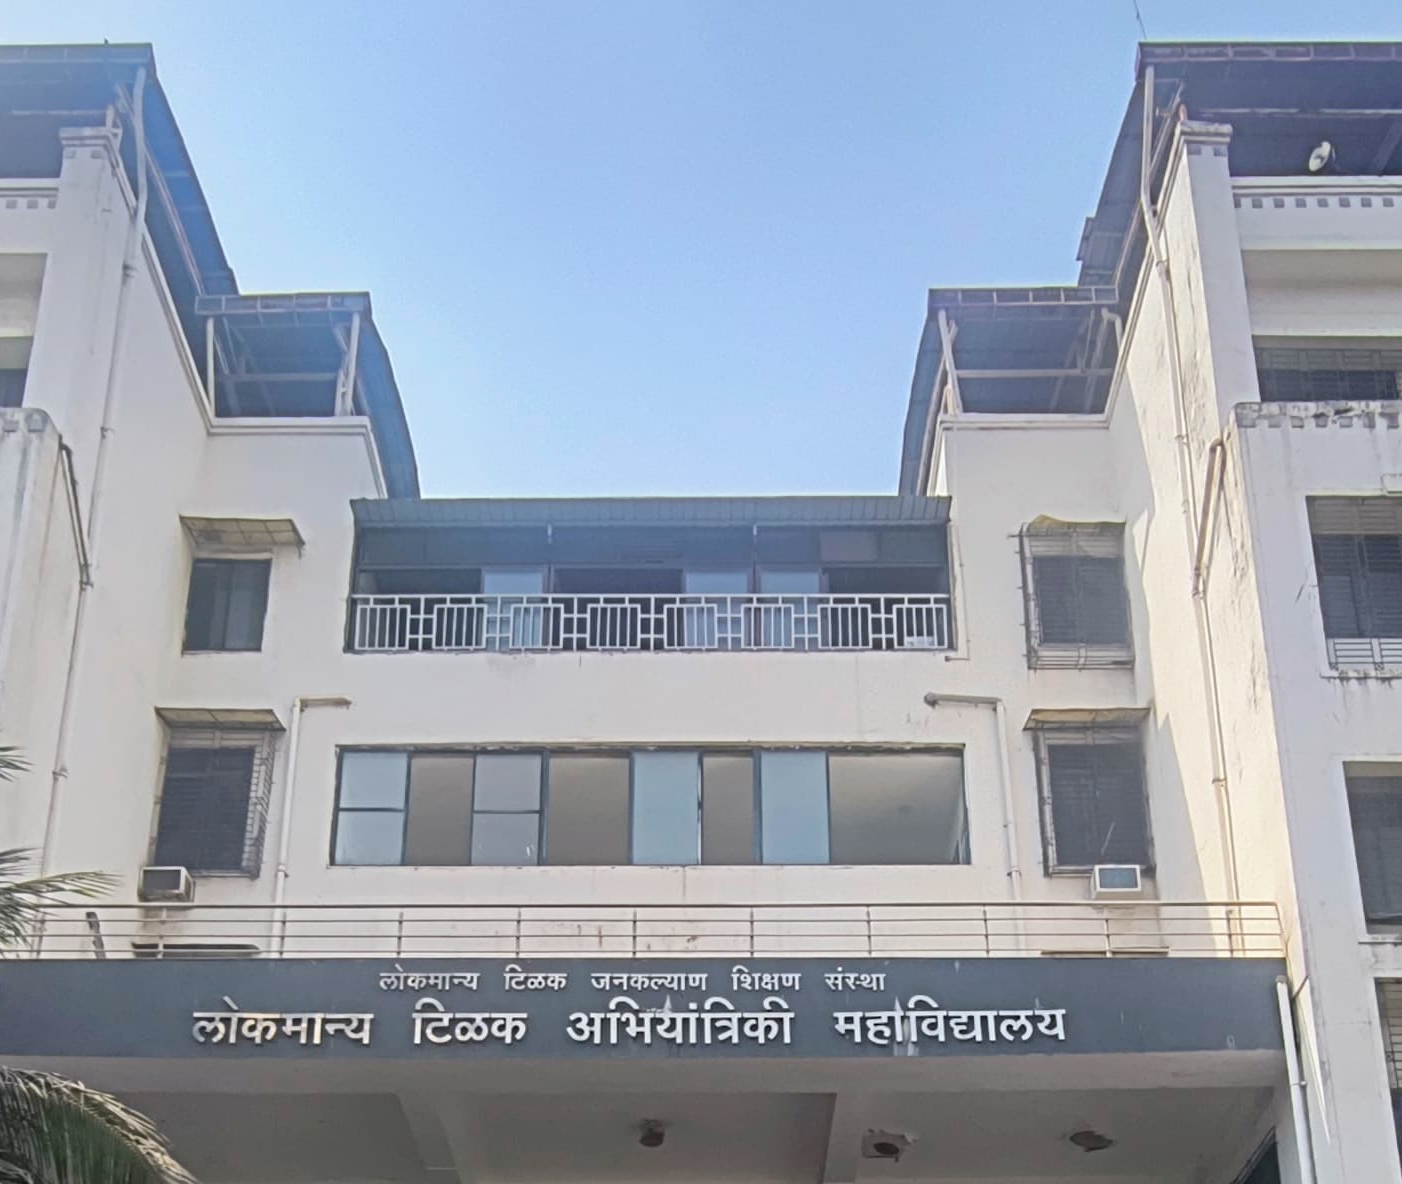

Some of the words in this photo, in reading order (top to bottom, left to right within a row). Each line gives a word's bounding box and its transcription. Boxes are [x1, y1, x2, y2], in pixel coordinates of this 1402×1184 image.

[379, 963, 480, 990] लोकमान्य
[503, 963, 568, 990] टिळक
[590, 972, 708, 991] जनकल्याण
[731, 964, 802, 991] शिक्षण
[824, 966, 886, 991] संस्था
[192, 995, 375, 1045] लोकमान्य
[412, 997, 528, 1044] टिळक
[566, 995, 795, 1044] अभियांत्रिकी
[833, 995, 1066, 1043] महाविद्यालय
